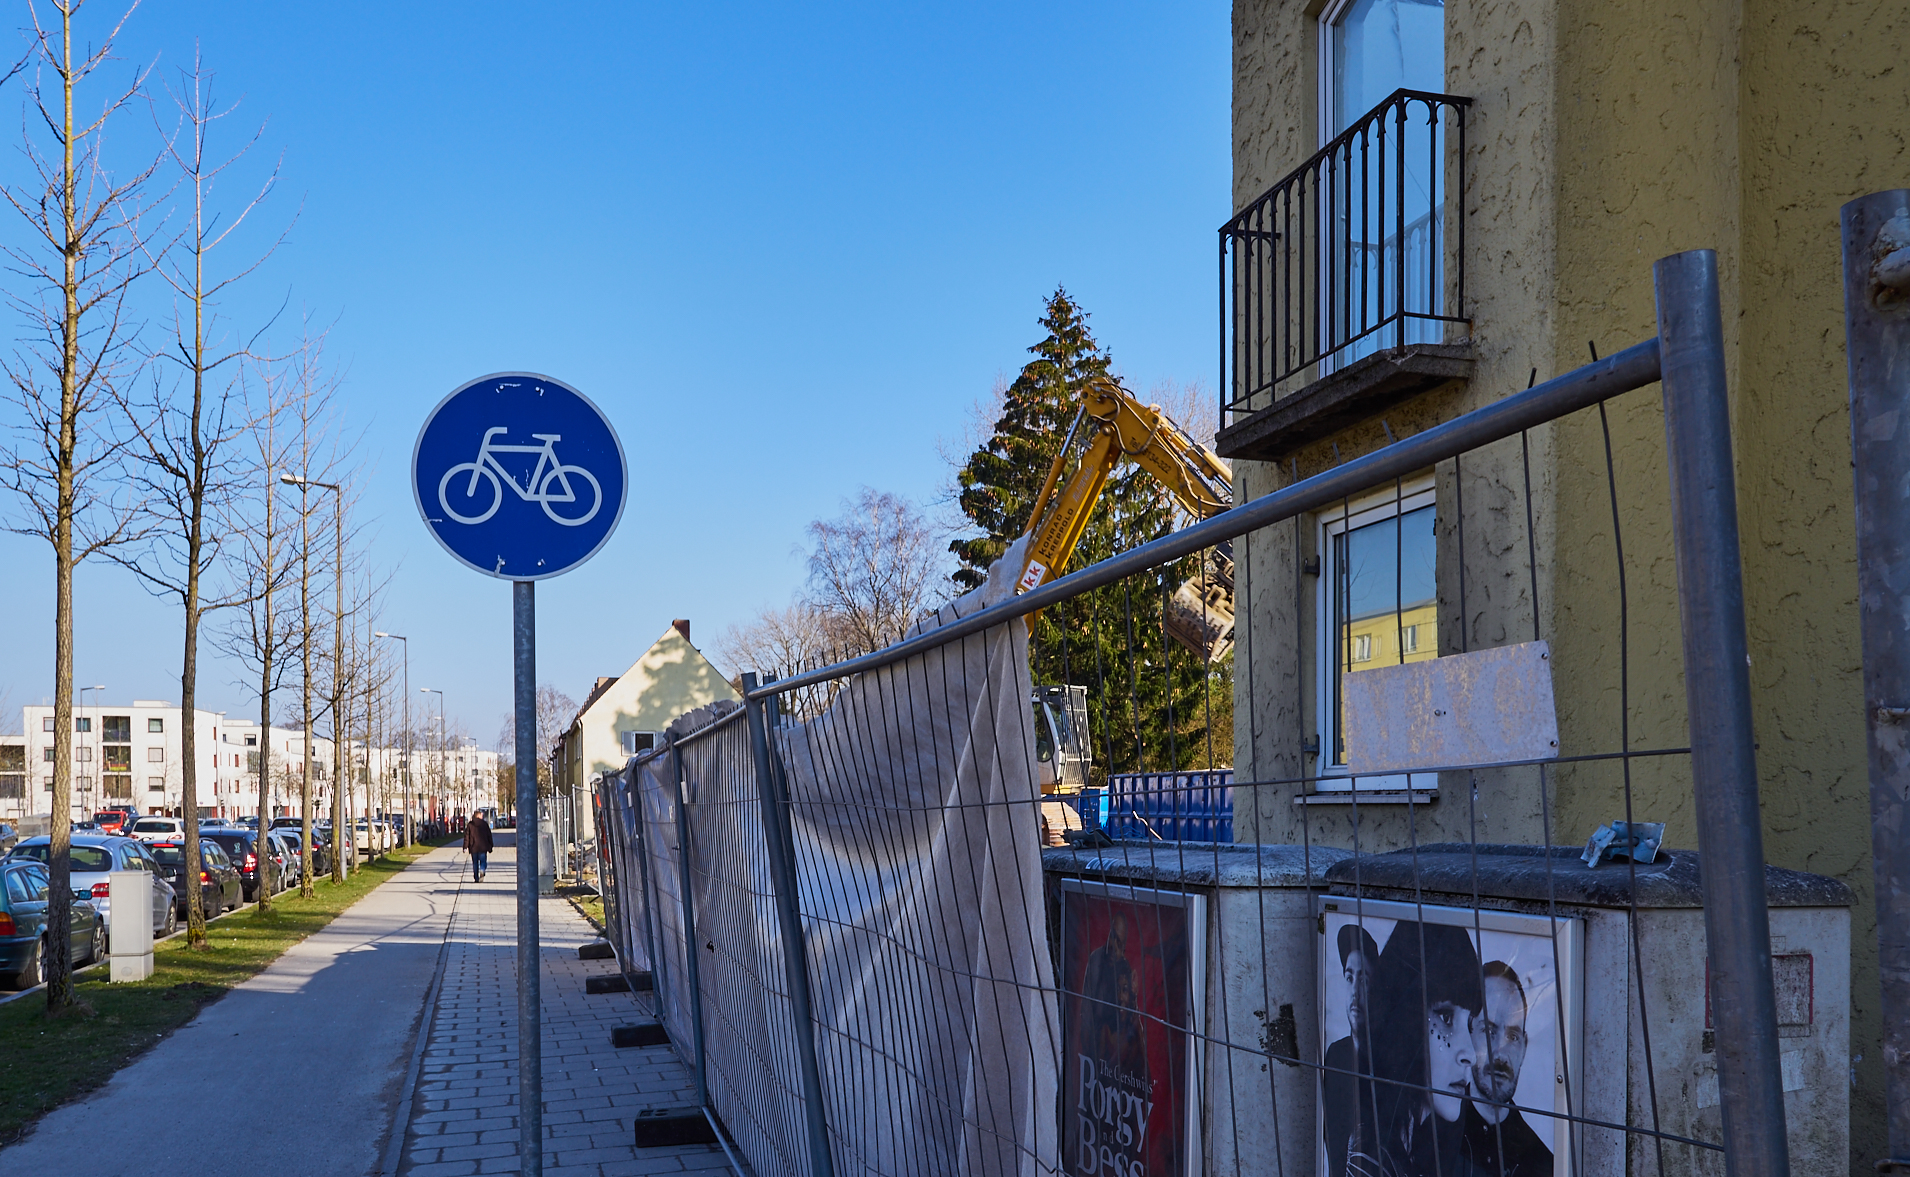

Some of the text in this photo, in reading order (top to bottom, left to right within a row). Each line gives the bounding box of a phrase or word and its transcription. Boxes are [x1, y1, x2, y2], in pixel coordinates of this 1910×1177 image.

[1039, 513, 1063, 556] KONRAD
[1045, 508, 1074, 560] KREPPOLD
[1100, 1058, 1113, 1077] The
[1078, 1052, 1154, 1153] Porgy
